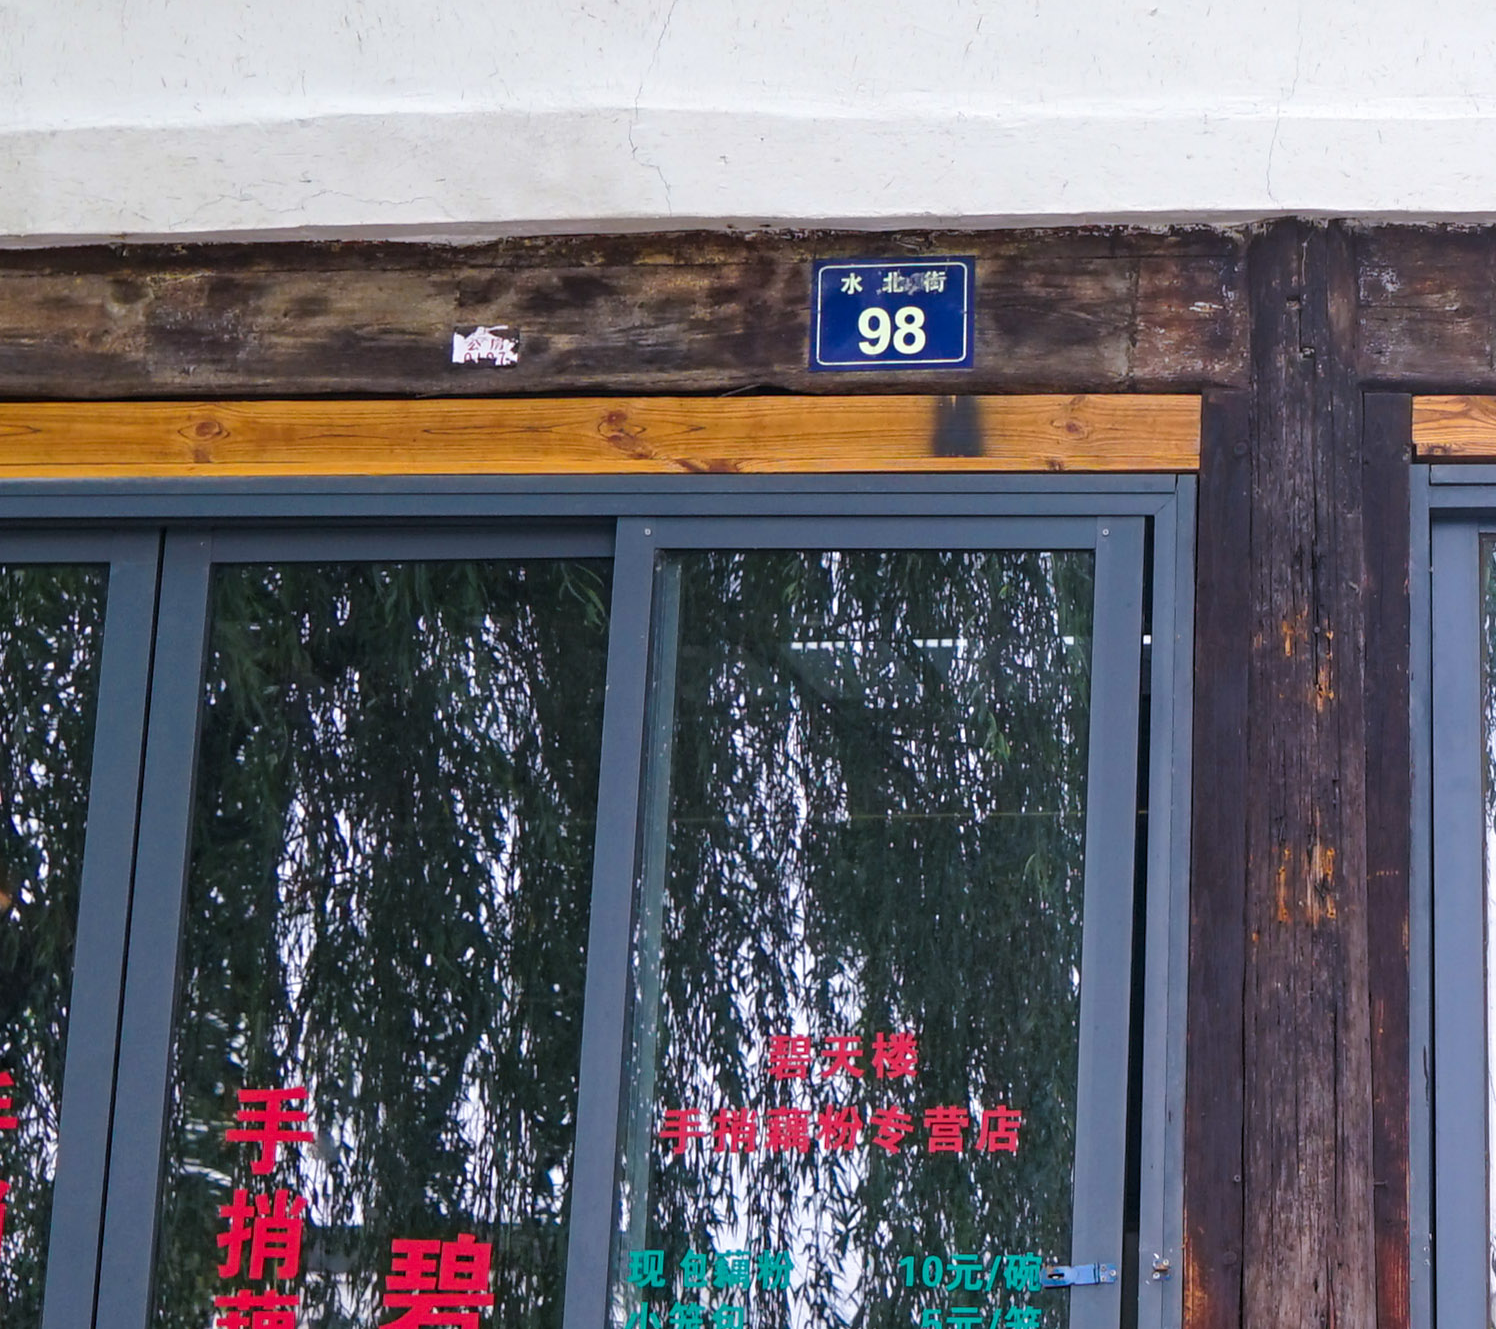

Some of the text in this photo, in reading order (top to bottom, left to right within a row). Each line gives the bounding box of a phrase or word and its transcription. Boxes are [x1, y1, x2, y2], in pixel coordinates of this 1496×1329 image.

[840, 271, 947, 295] 水北街
[858, 306, 926, 355] 98
[769, 1034, 918, 1081] 碧天楼
[660, 1106, 1022, 1155] 手捎藕粉专营店
[900, 1253, 1044, 1293] 10元/碗
